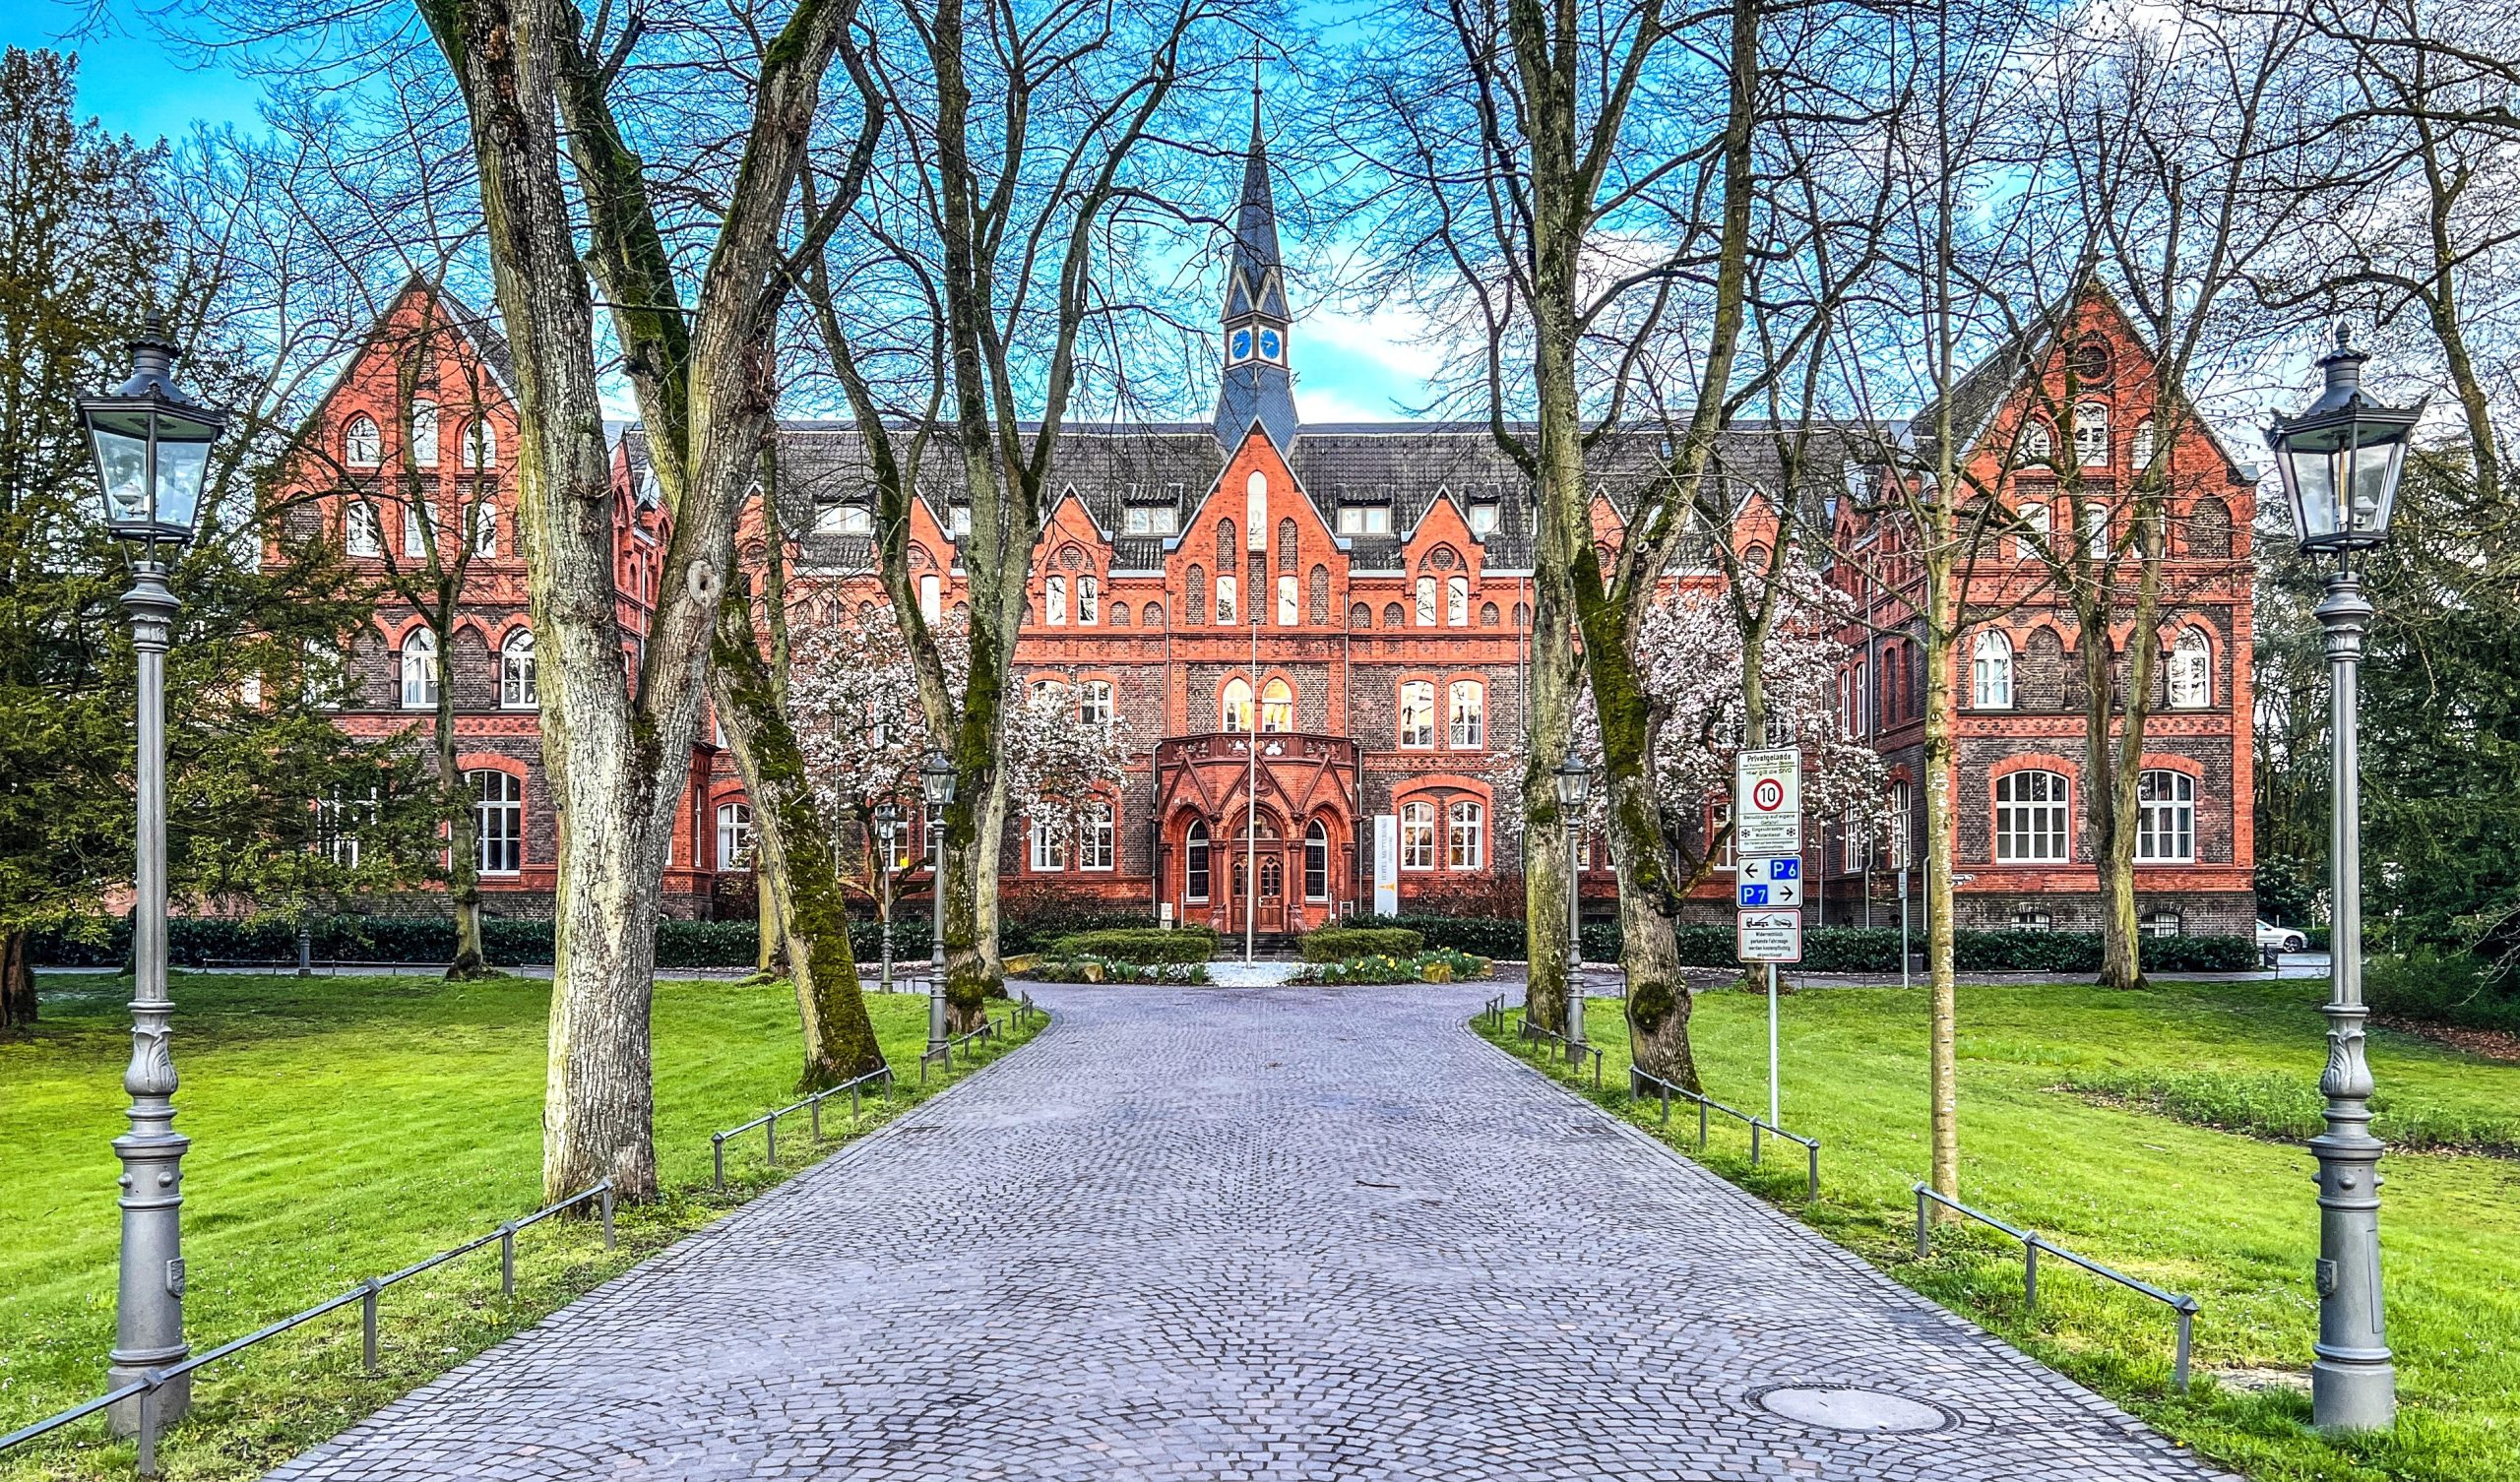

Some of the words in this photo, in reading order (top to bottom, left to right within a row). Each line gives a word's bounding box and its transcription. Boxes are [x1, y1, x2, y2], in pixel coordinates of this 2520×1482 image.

[1761, 787, 1776, 803] 10
[1774, 862, 1784, 877] P
[1789, 863, 1796, 877] 6
[1743, 887, 1754, 902] P
[1758, 890, 1766, 902] 7
